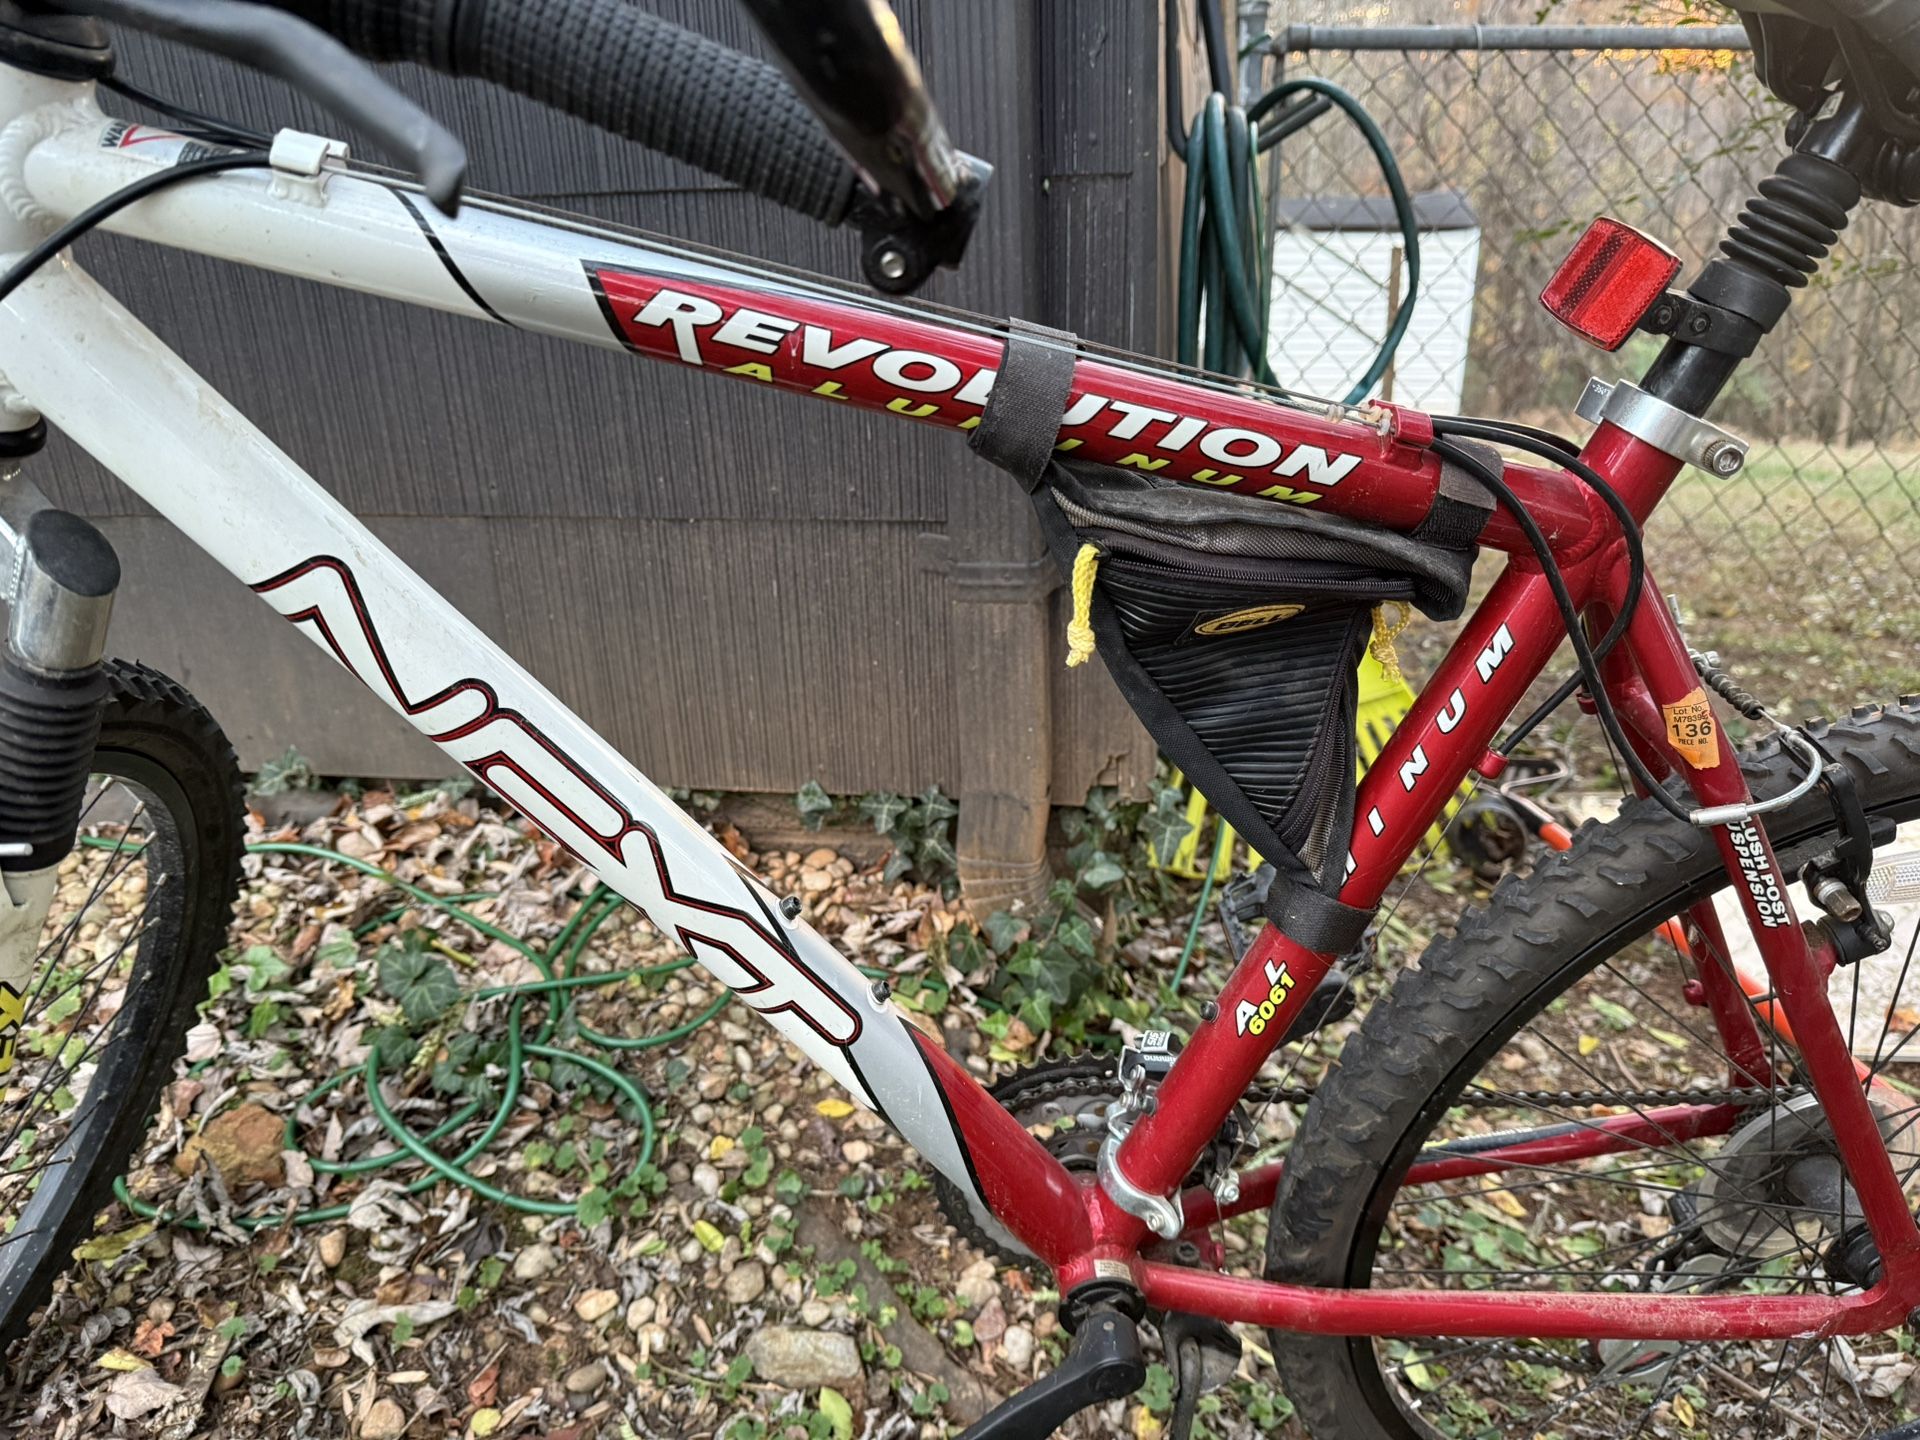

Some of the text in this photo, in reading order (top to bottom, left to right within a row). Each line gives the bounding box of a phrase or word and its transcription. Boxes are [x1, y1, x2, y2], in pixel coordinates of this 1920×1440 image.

[722, 362, 1323, 504] ALUINUM
[1672, 720, 1711, 737] 136
[1725, 821, 1779, 928] USPENSION
[1740, 814, 1792, 926] LUSH POST
[1247, 970, 1296, 1036] 6061
